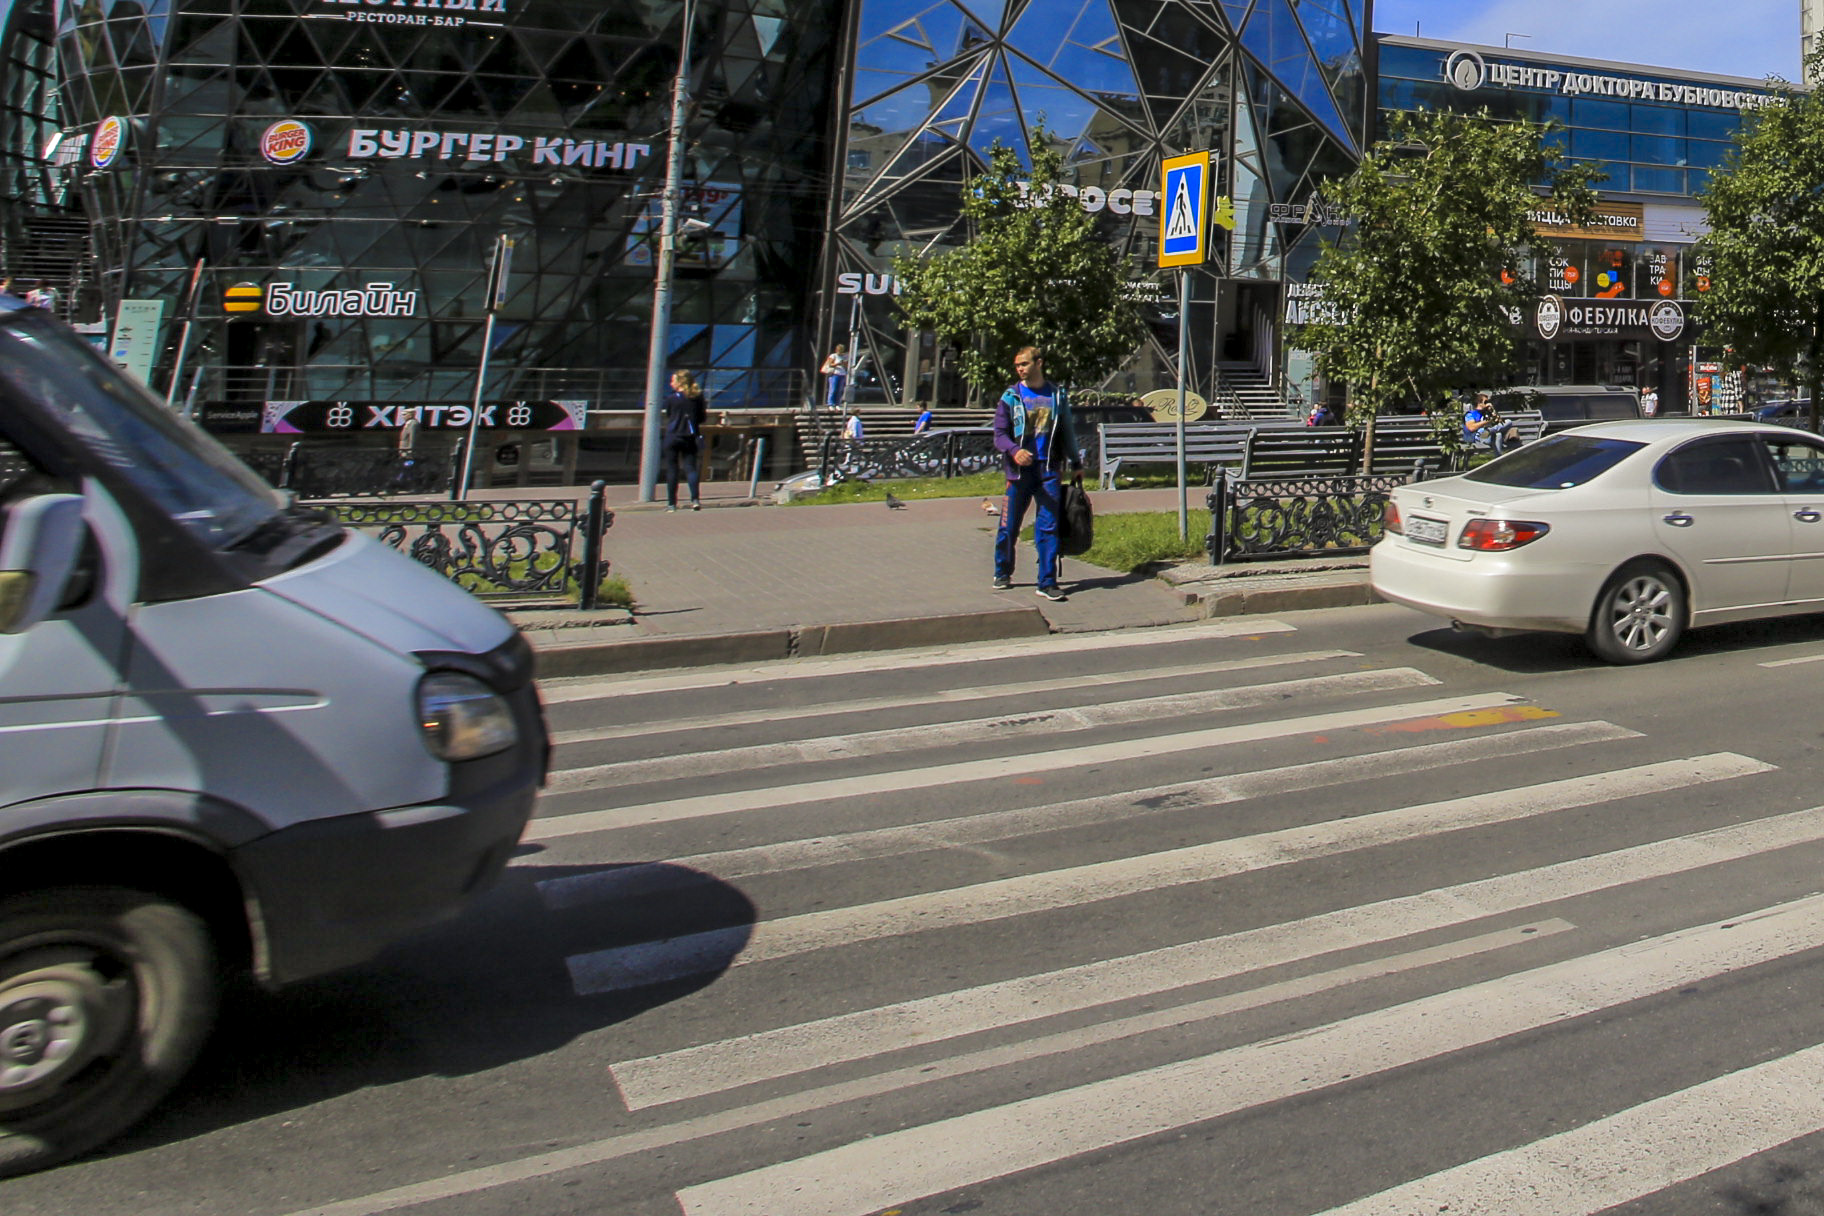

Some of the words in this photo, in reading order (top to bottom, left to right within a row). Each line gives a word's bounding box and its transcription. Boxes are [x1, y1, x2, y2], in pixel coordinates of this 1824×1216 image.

[346, 10, 465, 28] РЕСТОРАН-БАР
[1490, 63, 1560, 89] ЦЕНТР
[1562, 72, 1656, 101] ДОКТОРА
[268, 128, 306, 143] BURGER
[267, 139, 306, 155] KING
[349, 128, 525, 163] БУРГЕР
[532, 136, 651, 170] КИНГ
[1564, 307, 1649, 325] ФЕБУЛКА
[365, 405, 497, 427] ХИТЭК
